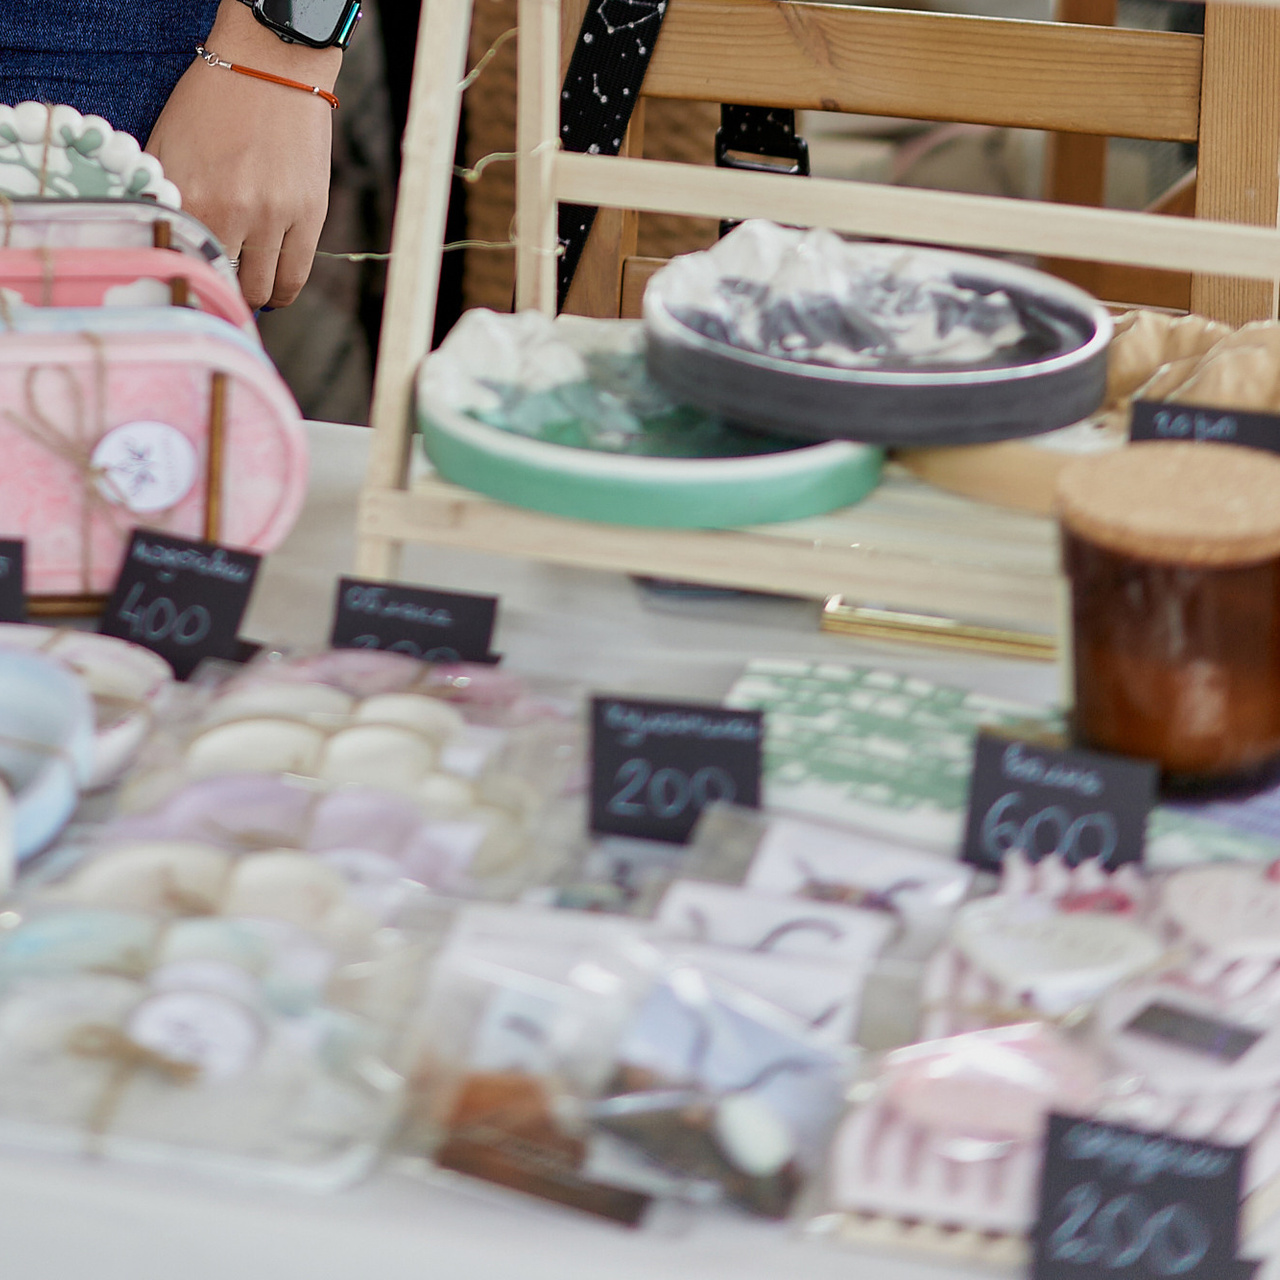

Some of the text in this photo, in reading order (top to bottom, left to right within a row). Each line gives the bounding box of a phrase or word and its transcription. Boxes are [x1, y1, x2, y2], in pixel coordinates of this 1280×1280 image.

[118, 581, 211, 644] 400
[606, 757, 737, 818] 200
[983, 791, 1117, 864] 600
[1050, 1182, 1211, 1274] 200
